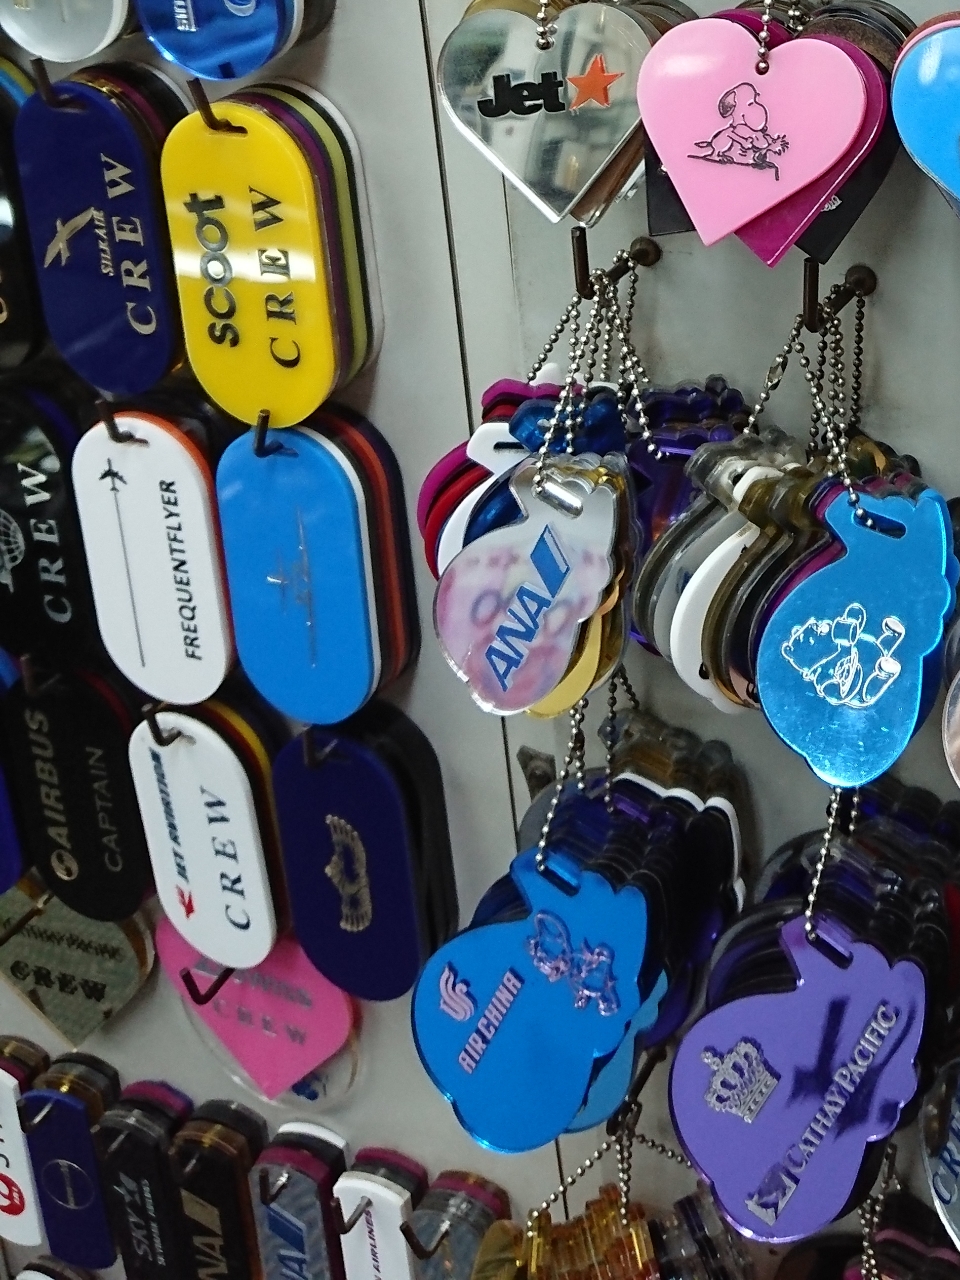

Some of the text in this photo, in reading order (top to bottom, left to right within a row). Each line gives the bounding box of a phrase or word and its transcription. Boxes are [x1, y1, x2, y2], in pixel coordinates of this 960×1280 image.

[477, 71, 566, 118] Jet
[92, 209, 114, 277] SILKAIR
[100, 152, 157, 336] CREW
[182, 192, 241, 348] scoot
[248, 185, 302, 370] CREW
[17, 462, 72, 624] CREW
[484, 581, 553, 694] ANA
[24, 707, 69, 849] AIRBUS
[85, 746, 123, 873] CAPTAIN
[199, 785, 252, 931] CREW
[458, 967, 525, 1075] AIR CHINA
[788, 1003, 898, 1174] CATHAY PACIFIC
[363, 1208, 382, 1272] AIRLINES
